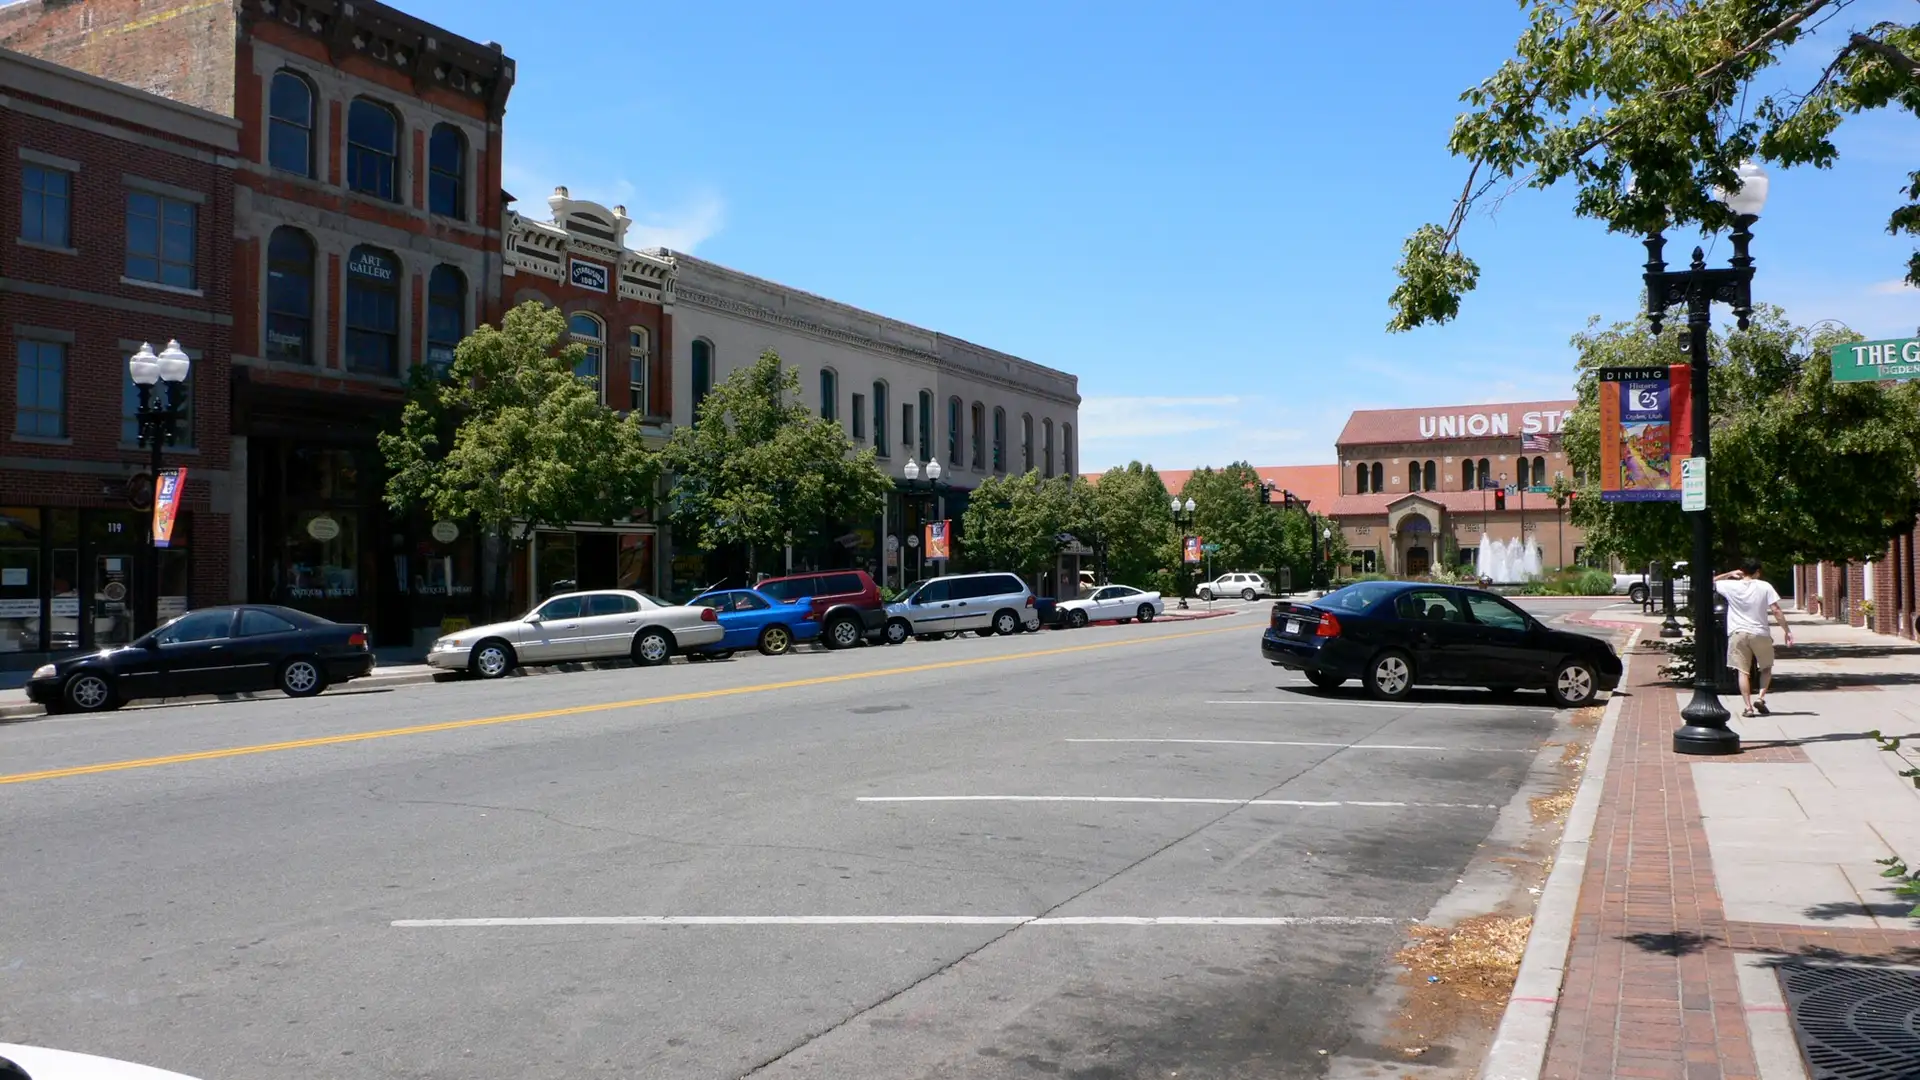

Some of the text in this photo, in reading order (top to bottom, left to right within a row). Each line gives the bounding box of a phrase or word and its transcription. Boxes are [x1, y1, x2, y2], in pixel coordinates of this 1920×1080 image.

[360, 254, 383, 267] ART
[349, 261, 392, 280] GALLERY
[1851, 343, 1898, 366] THE
[1606, 370, 1662, 380] DINING
[1641, 391, 1659, 408] 25
[1419, 412, 1509, 438] UNION
[1682, 460, 1690, 476] 2
[107, 522, 122, 533] 119
